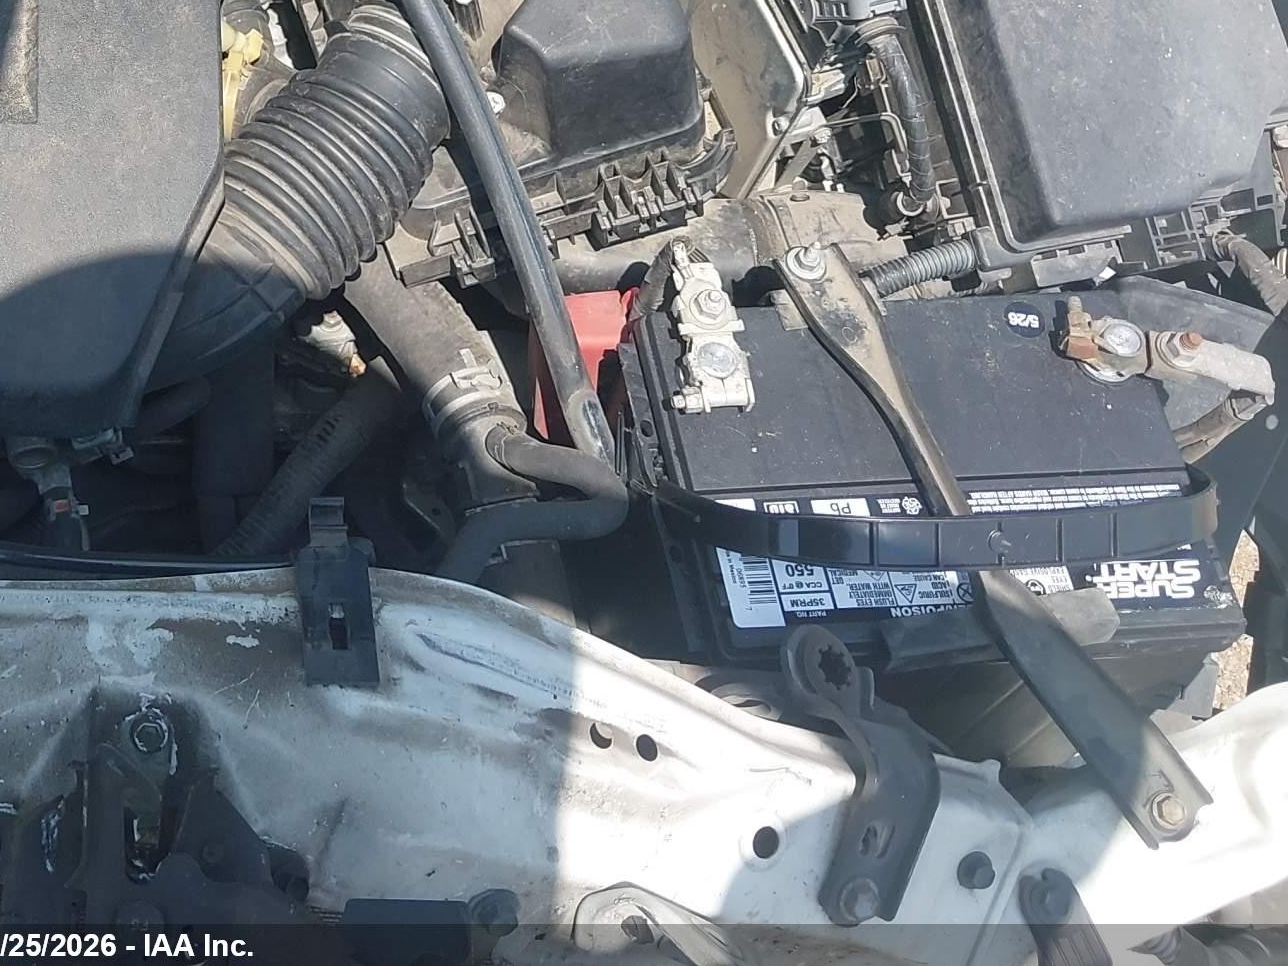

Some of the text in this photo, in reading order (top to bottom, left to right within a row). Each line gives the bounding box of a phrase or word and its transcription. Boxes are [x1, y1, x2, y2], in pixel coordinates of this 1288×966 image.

[1008, 311, 1040, 328] 5/26
[830, 502, 851, 515] Pb
[785, 564, 814, 577] 550
[1092, 561, 1200, 584] START
[795, 581, 803, 589] @
[805, 581, 823, 590] CCA
[870, 582, 889, 590] WITH
[931, 581, 947, 589] ACID
[1096, 580, 1195, 599] SUPER
[849, 590, 892, 598] IMMEDIATELY
[918, 590, 950, 599] SULFURIC
[789, 597, 826, 608] 35PRM
[856, 598, 872, 606] EYES
